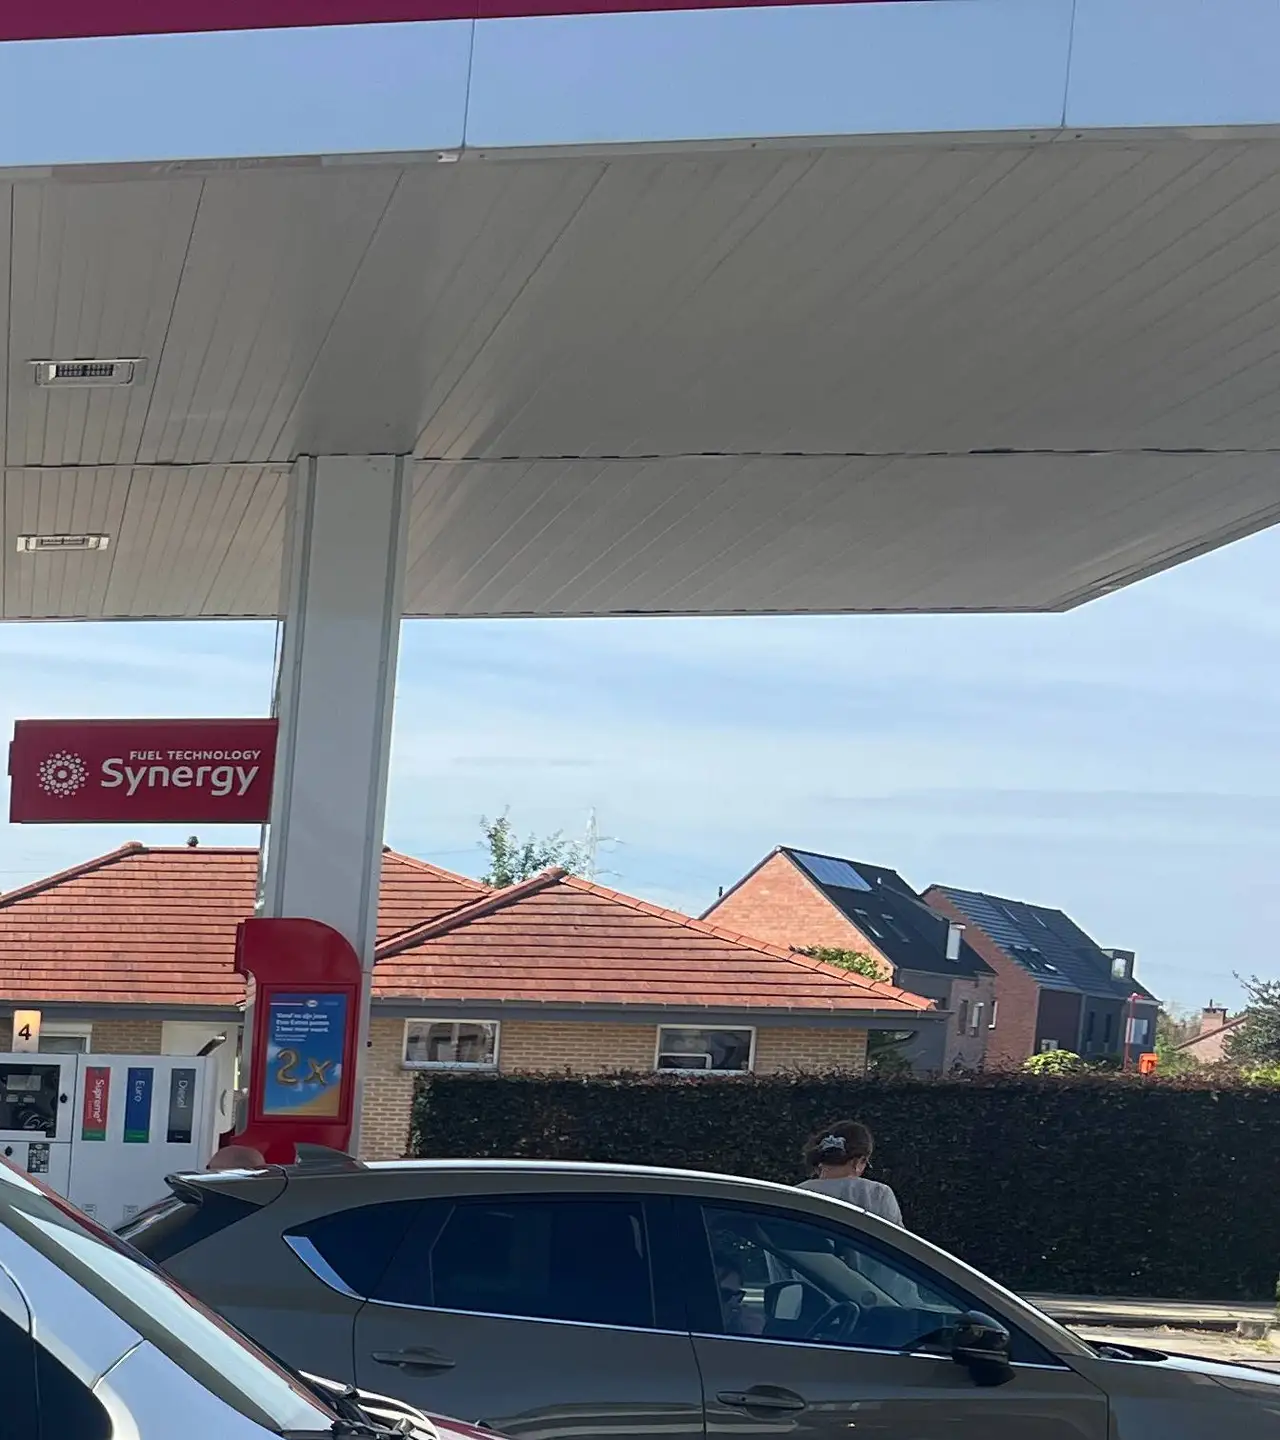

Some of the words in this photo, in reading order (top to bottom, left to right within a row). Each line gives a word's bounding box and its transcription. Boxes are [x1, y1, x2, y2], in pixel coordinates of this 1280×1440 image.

[129, 750, 163, 761] FUEL
[167, 749, 262, 761] TECHNOLOGY
[100, 758, 260, 797] Synergy
[18, 1024, 31, 1040] 4
[134, 1080, 146, 1103] Euro
[176, 1080, 189, 1108] Diesel
